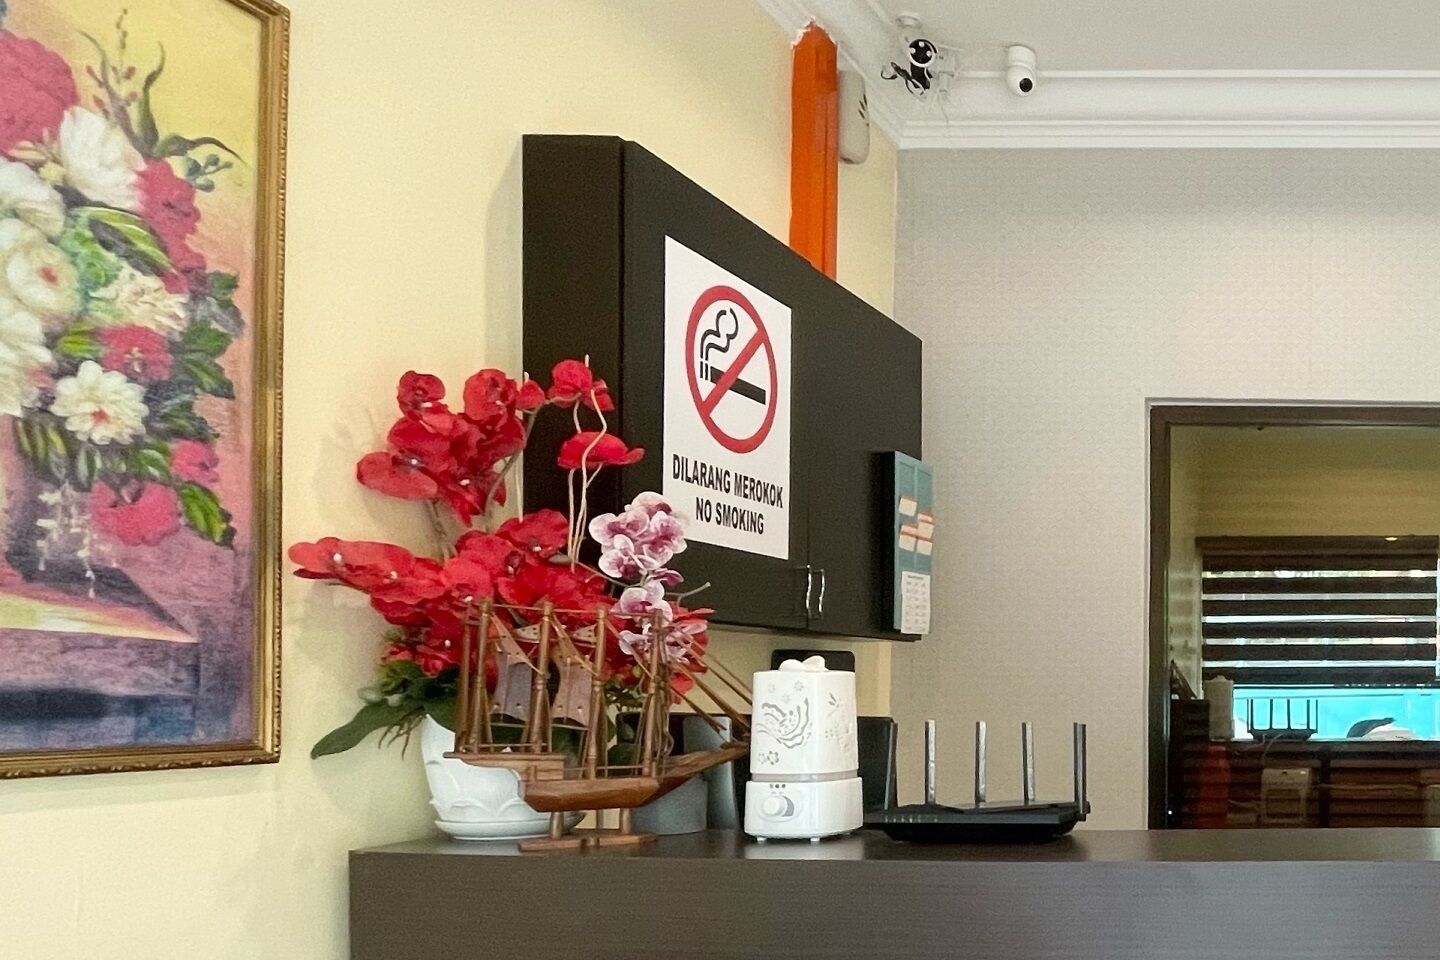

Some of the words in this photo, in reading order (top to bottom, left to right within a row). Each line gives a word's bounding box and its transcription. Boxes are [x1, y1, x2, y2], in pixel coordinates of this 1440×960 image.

[673, 454, 730, 493] DILARANG
[734, 473, 783, 508] MEROKOK
[696, 497, 712, 522] NO
[716, 502, 764, 534] SMOKING
